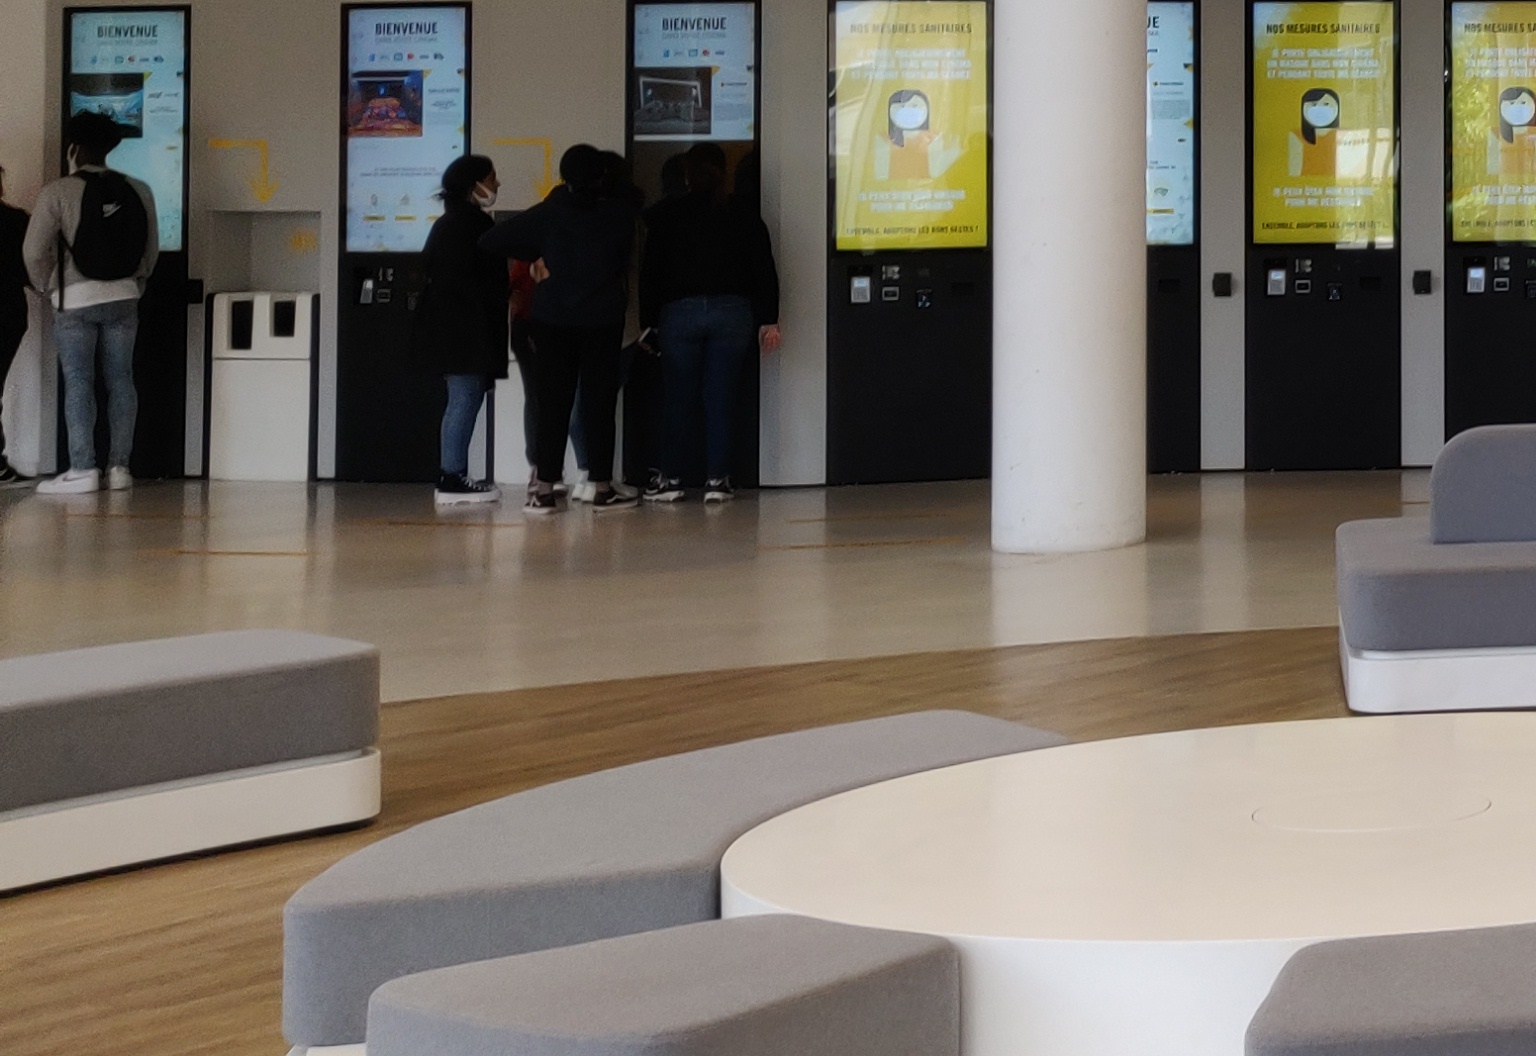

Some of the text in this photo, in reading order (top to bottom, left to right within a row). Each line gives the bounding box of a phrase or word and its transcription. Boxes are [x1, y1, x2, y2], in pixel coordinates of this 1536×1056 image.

[375, 22, 438, 36] BIENVENUE
[662, 17, 727, 32] BIENVENUE
[1266, 23, 1284, 34] NOS
[1286, 23, 1328, 34] MESURES
[97, 25, 158, 38] BIENVENUE
